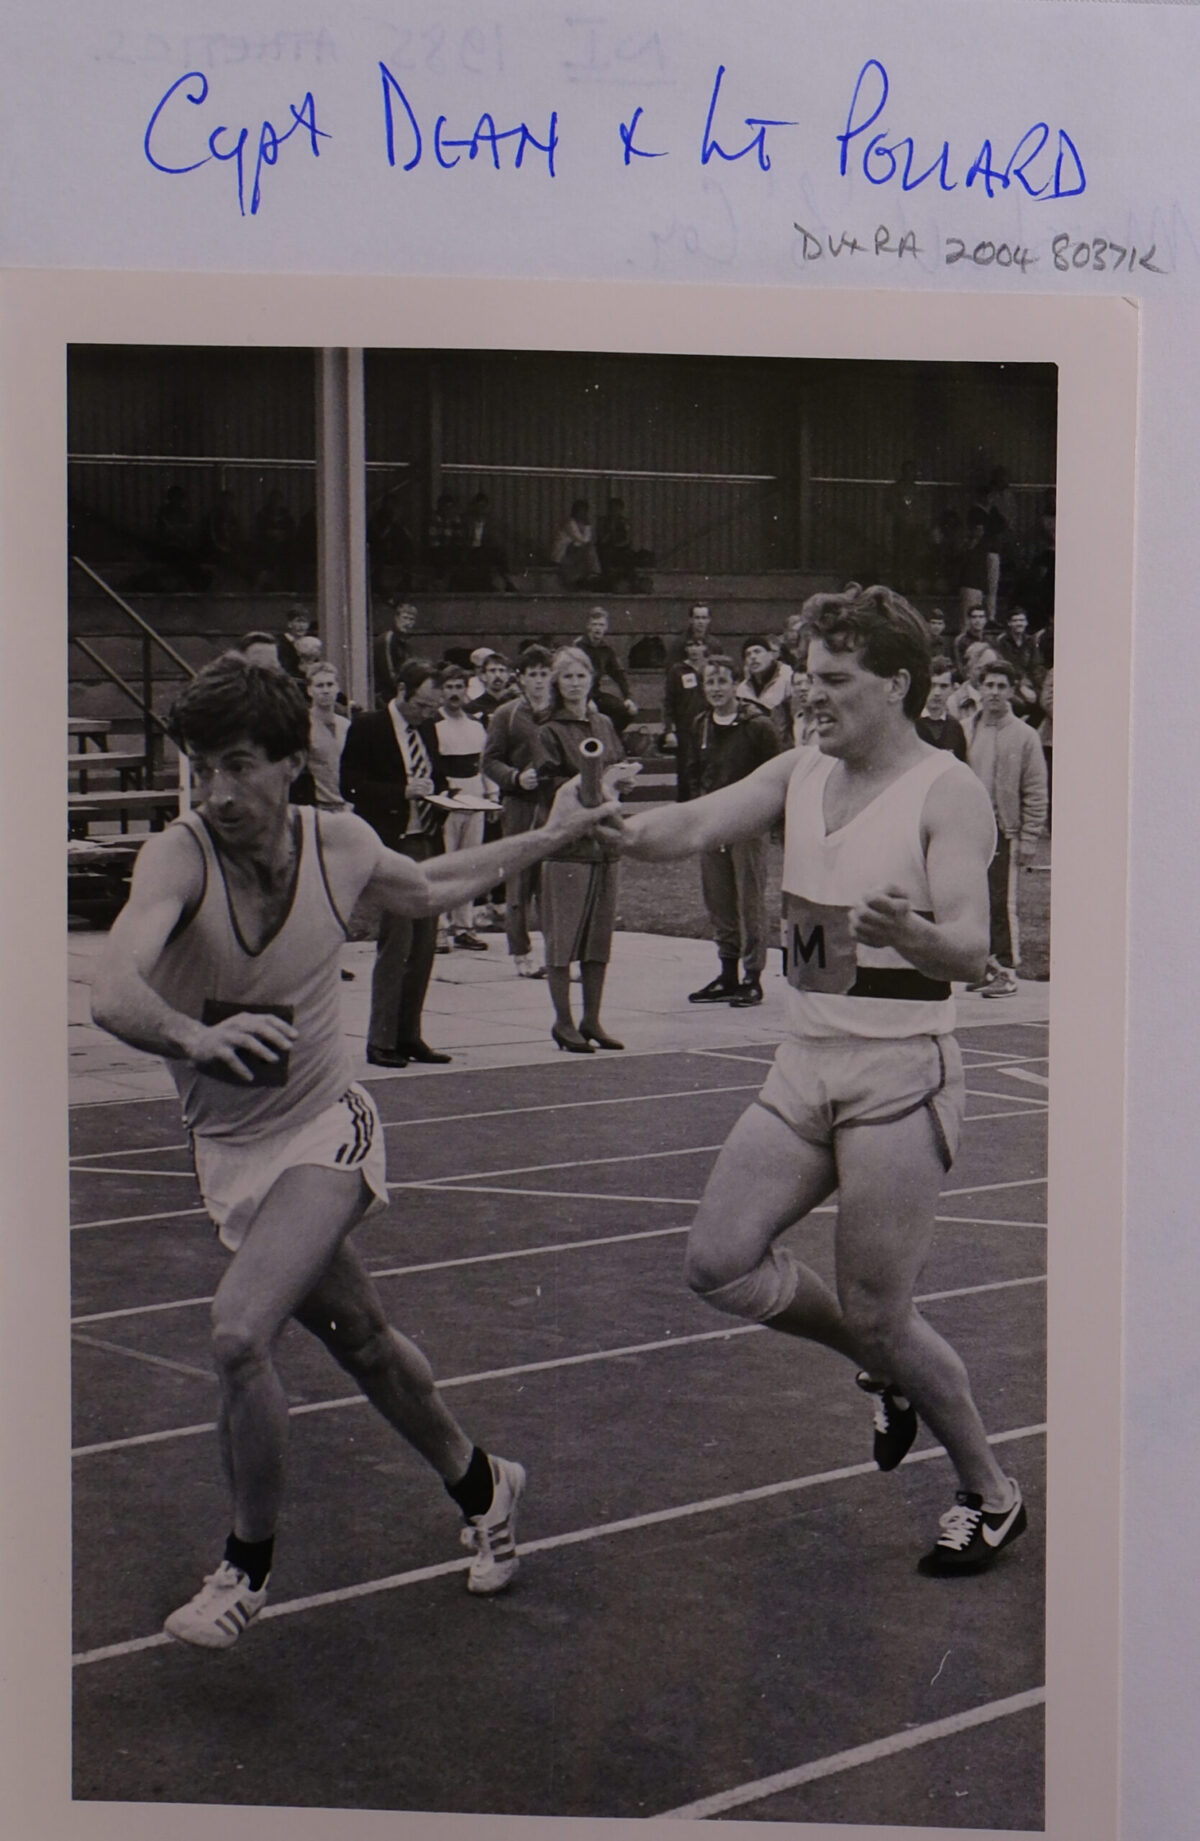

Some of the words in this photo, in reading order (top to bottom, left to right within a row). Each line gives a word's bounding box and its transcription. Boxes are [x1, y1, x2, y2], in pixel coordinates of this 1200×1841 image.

[379, 60, 559, 178] DEAN
[945, 237, 1038, 274] 2004
[793, 923, 827, 970] M
